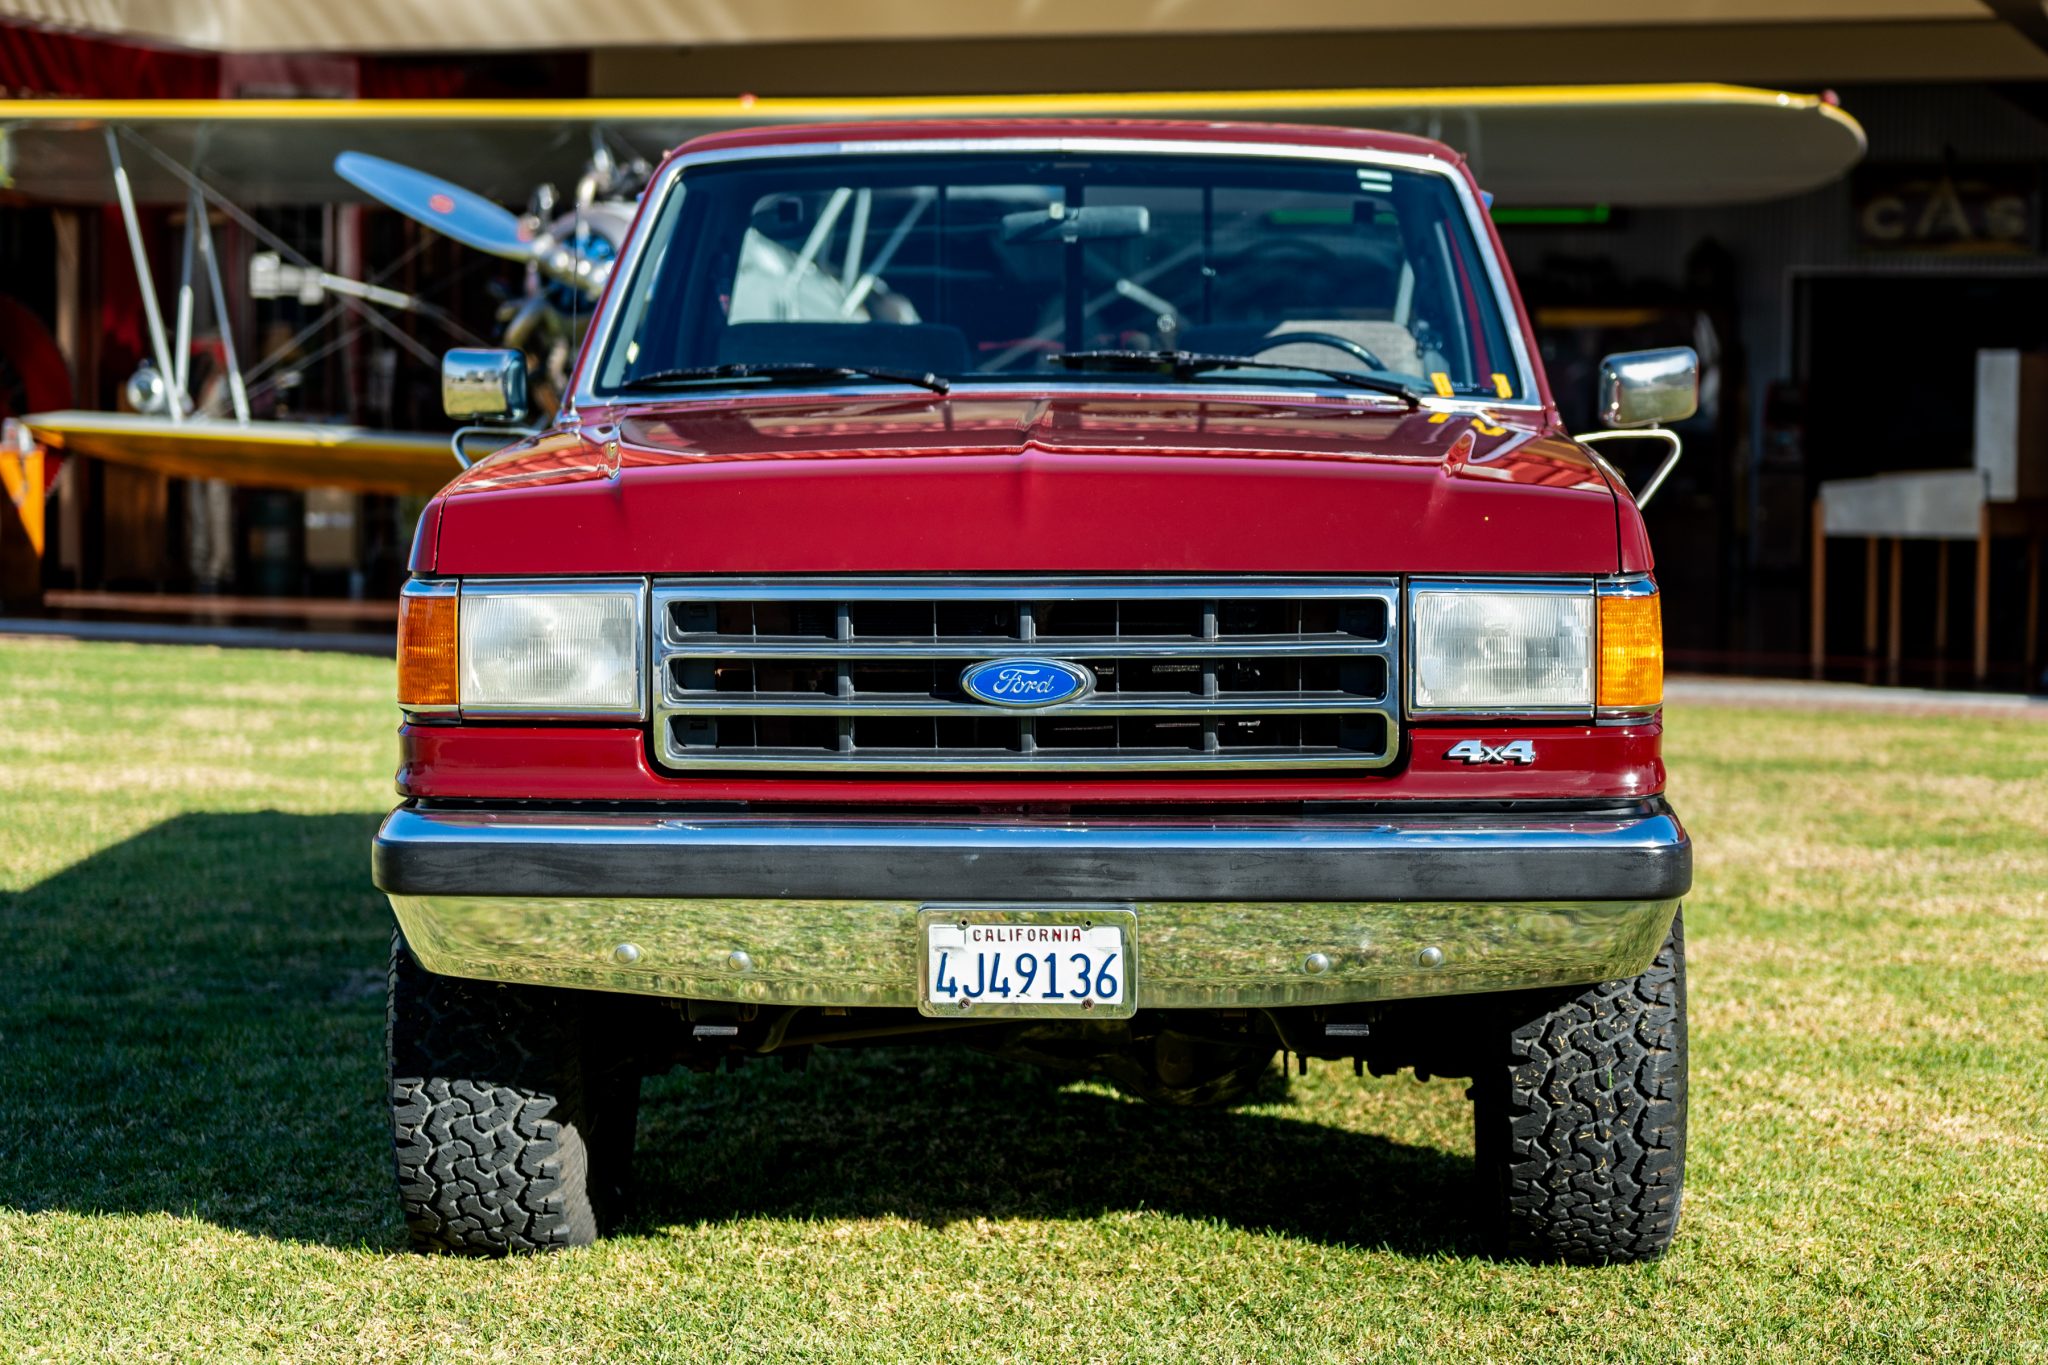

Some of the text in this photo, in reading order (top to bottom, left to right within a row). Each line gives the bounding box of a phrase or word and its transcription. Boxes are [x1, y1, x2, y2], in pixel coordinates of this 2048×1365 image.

[993, 668, 1054, 694] Ford
[1445, 739, 1536, 764] 4x4
[973, 928, 1081, 942] CALIFORNIA
[936, 953, 1118, 998] 4J49136
